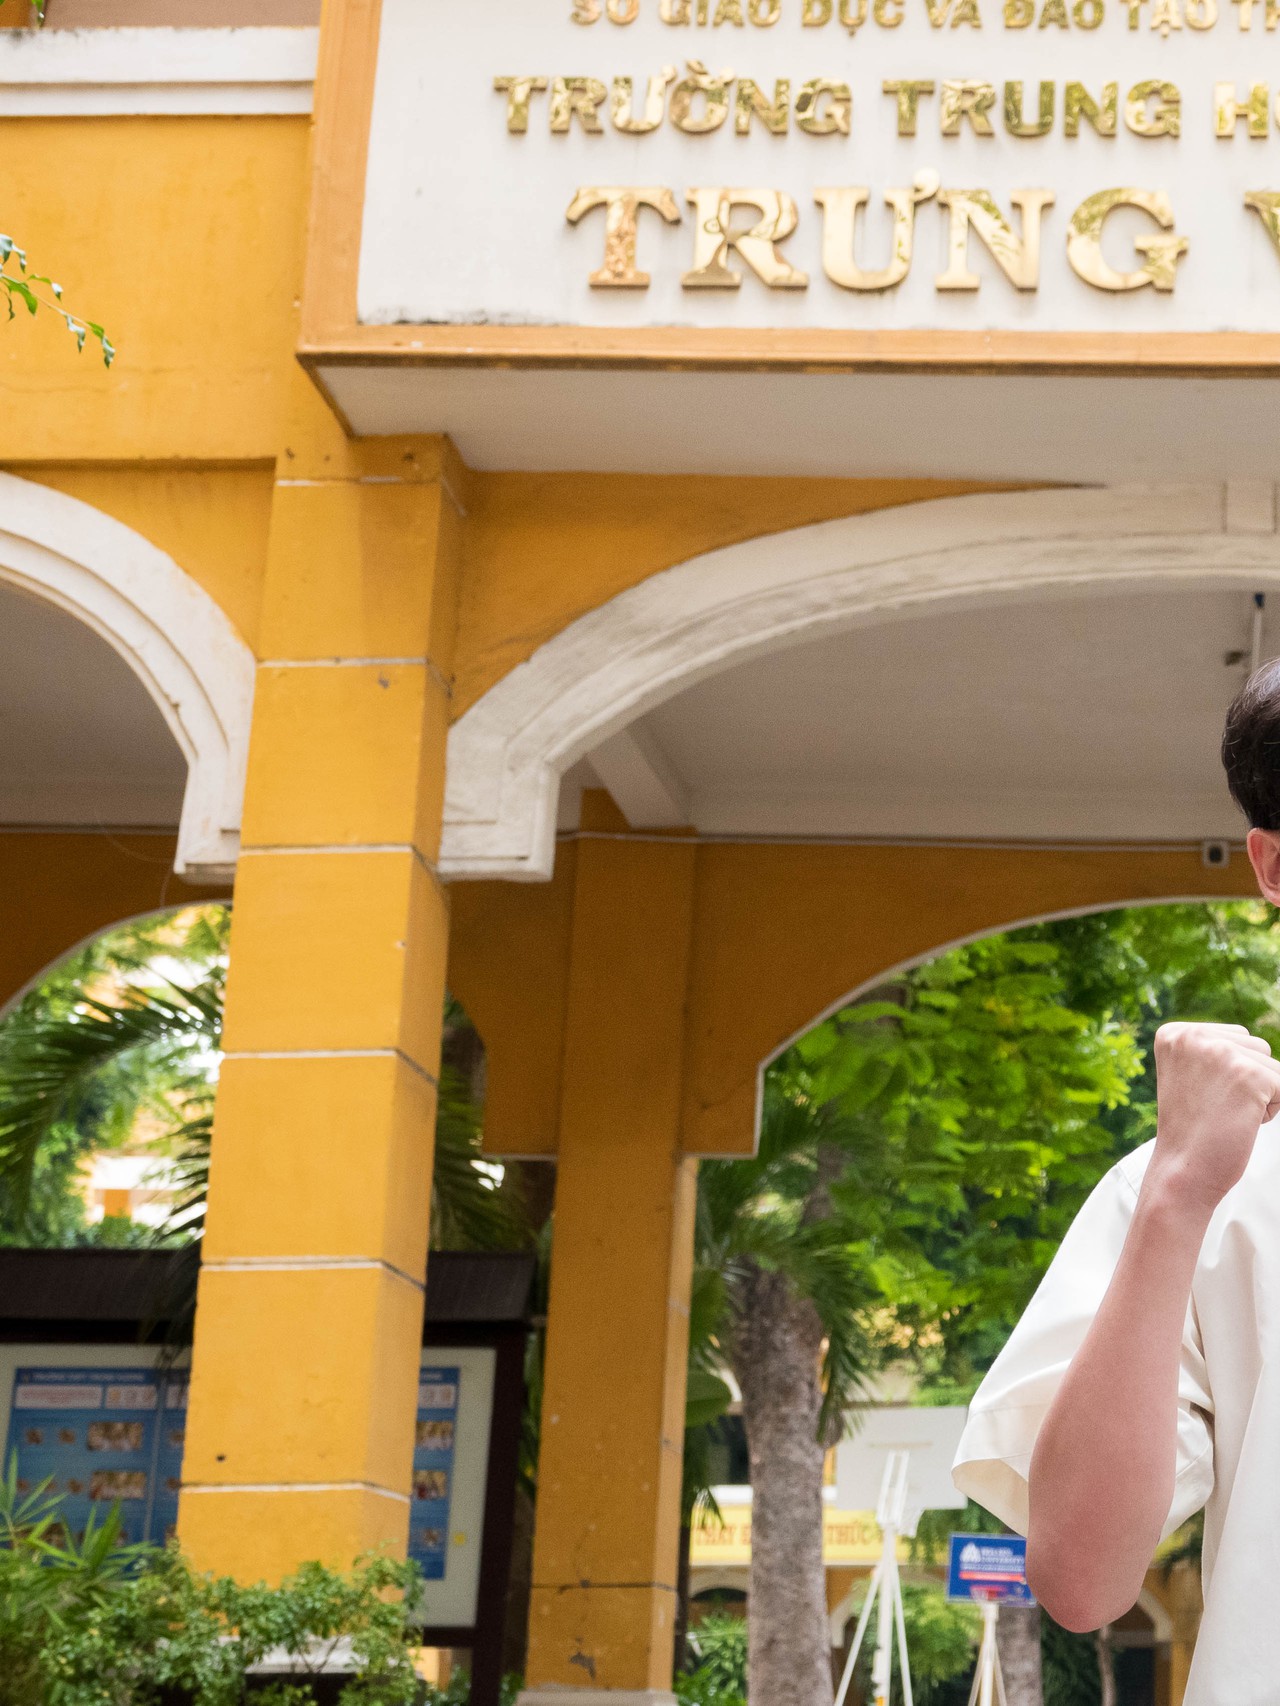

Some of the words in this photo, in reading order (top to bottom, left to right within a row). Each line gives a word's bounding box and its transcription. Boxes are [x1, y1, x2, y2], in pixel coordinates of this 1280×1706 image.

[493, 59, 852, 137] TRƯỜNG
[882, 78, 1182, 138] TRUNG
[565, 168, 1190, 293] TRƯNG
